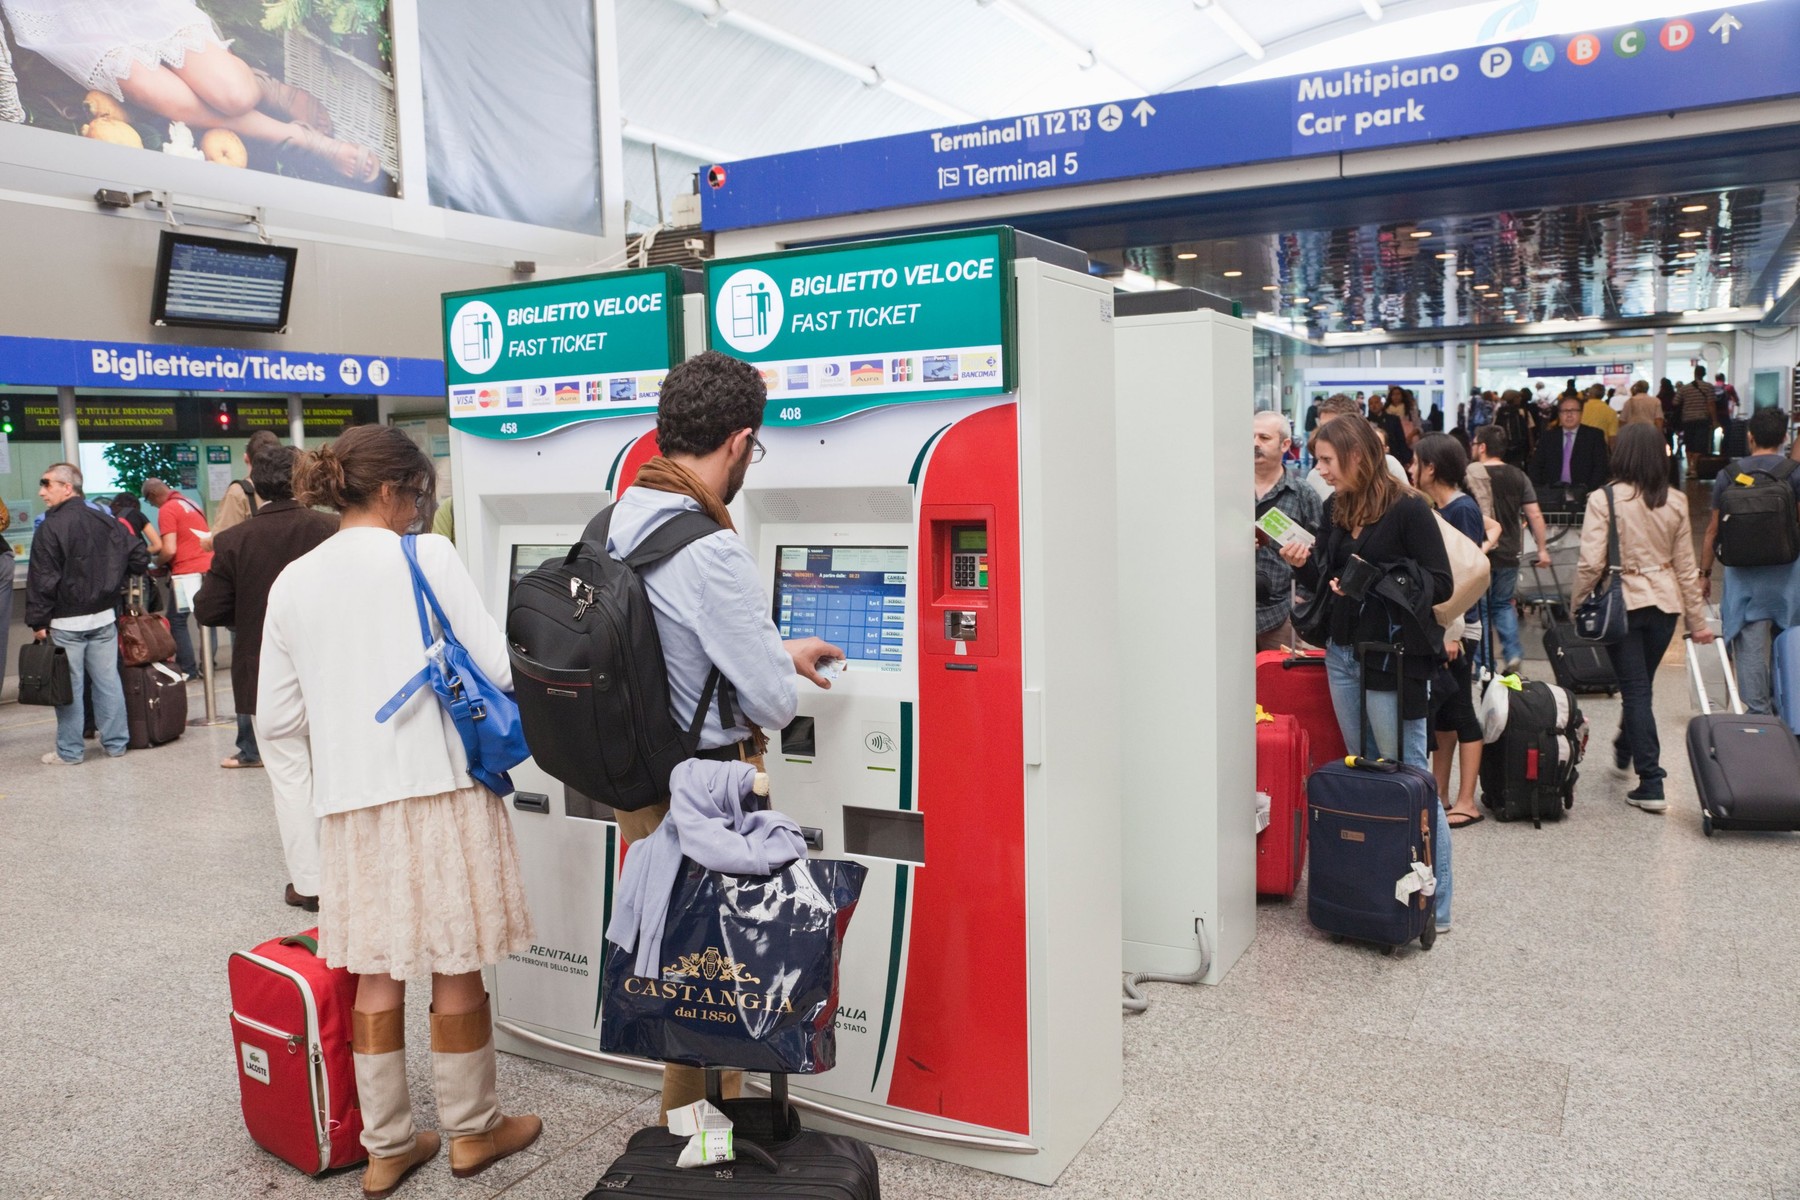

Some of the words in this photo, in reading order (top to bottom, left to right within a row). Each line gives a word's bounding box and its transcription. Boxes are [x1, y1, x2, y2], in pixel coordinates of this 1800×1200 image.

[1297, 63, 1459, 102] Multipiano
[1529, 46, 1549, 67] A
[1576, 39, 1593, 61] B
[1619, 32, 1637, 53] C
[1668, 25, 1688, 46] D
[1297, 109, 1347, 136] Car
[1355, 98, 1425, 135] park
[931, 119, 1022, 153] Terminal
[1043, 111, 1066, 136] T2
[1069, 108, 1091, 132] T3
[963, 154, 1057, 187] Terminal
[1063, 152, 1079, 175] 5
[790, 268, 898, 297] BIGLIETTO
[904, 258, 994, 286] VELOCE
[507, 300, 589, 327] BIGLIETTO
[594, 293, 662, 317] VELOCE
[792, 310, 842, 333] FAST
[847, 303, 922, 328] TICKET
[508, 338, 547, 357] FAST
[551, 332, 607, 354] TICKET
[91, 349, 326, 381] Biglietteria/Tickets
[1, 401, 10, 411] 3
[219, 402, 228, 412] 4
[456, 395, 474, 405] VISA
[36, 418, 61, 426] TICKE
[77, 418, 90, 426] OR
[779, 407, 801, 421] 408
[500, 422, 518, 434] 458
[528, 944, 588, 966] RENITALIA
[521, 956, 549, 969] FERROVIE
[549, 962, 569, 973] DELLO
[570, 967, 589, 977] STATO
[623, 977, 796, 1013] CASTANGIA
[674, 1006, 697, 1019] dal
[701, 1009, 737, 1024] 1850
[843, 1022, 867, 1034] STATO
[245, 1061, 267, 1077] LACOSTE
